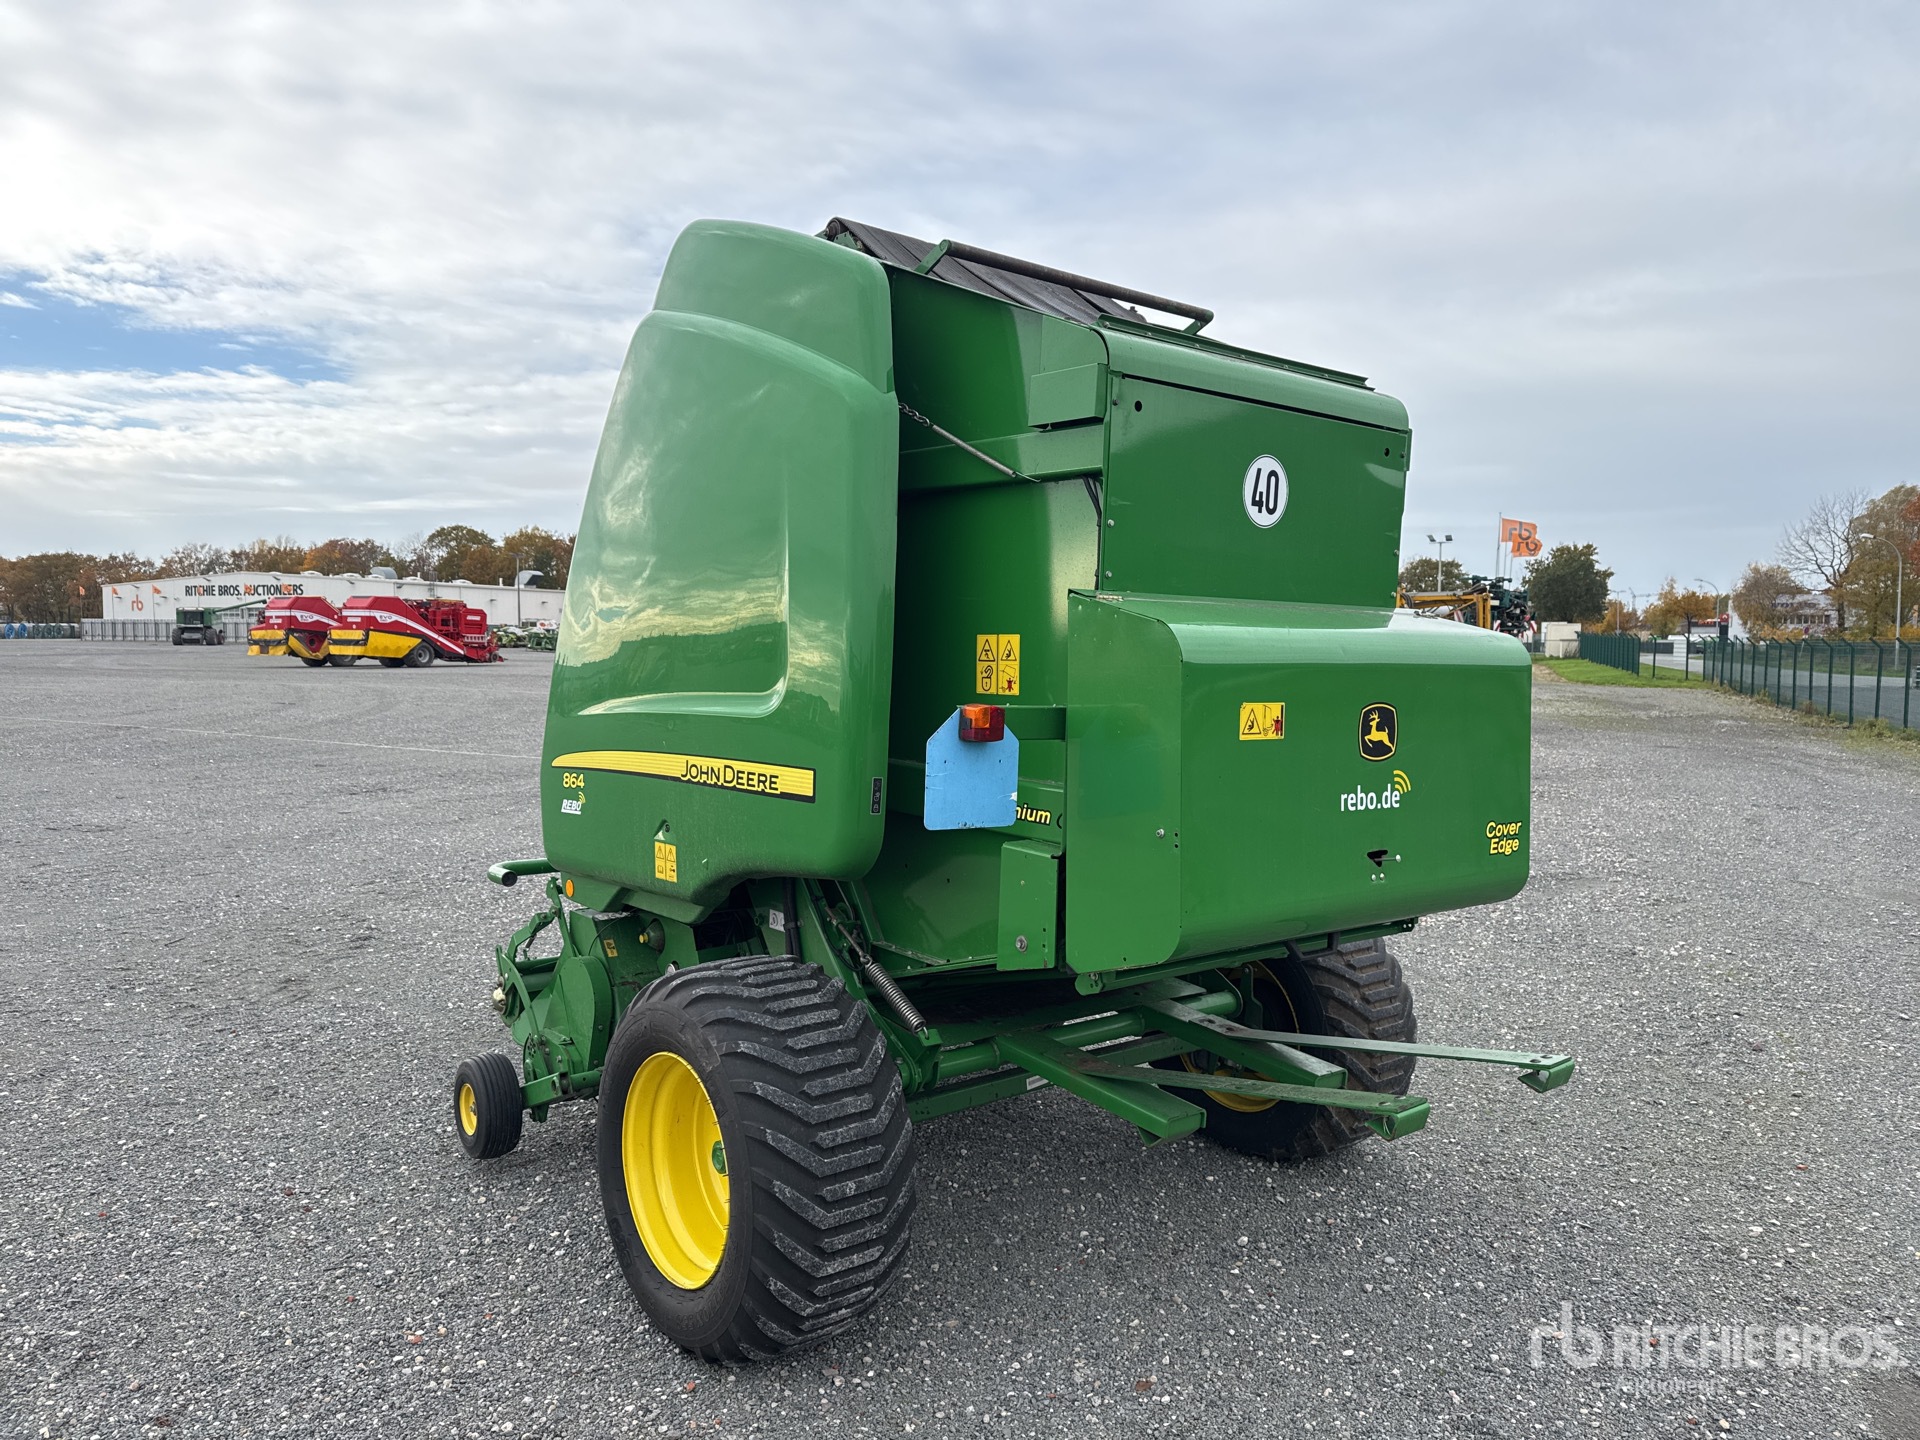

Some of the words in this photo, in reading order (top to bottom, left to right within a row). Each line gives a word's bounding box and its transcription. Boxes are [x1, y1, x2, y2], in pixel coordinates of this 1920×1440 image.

[1251, 467, 1280, 516] 40
[217, 584, 242, 597] BROS.
[131, 593, 144, 612] rb
[562, 772, 585, 789] 864
[680, 759, 721, 783] JOHN
[723, 764, 780, 791] DEERE
[562, 798, 582, 812] REBO
[1340, 783, 1400, 812] rebo.de
[1486, 821, 1522, 838] Cover
[1489, 837, 1520, 856] Edge
